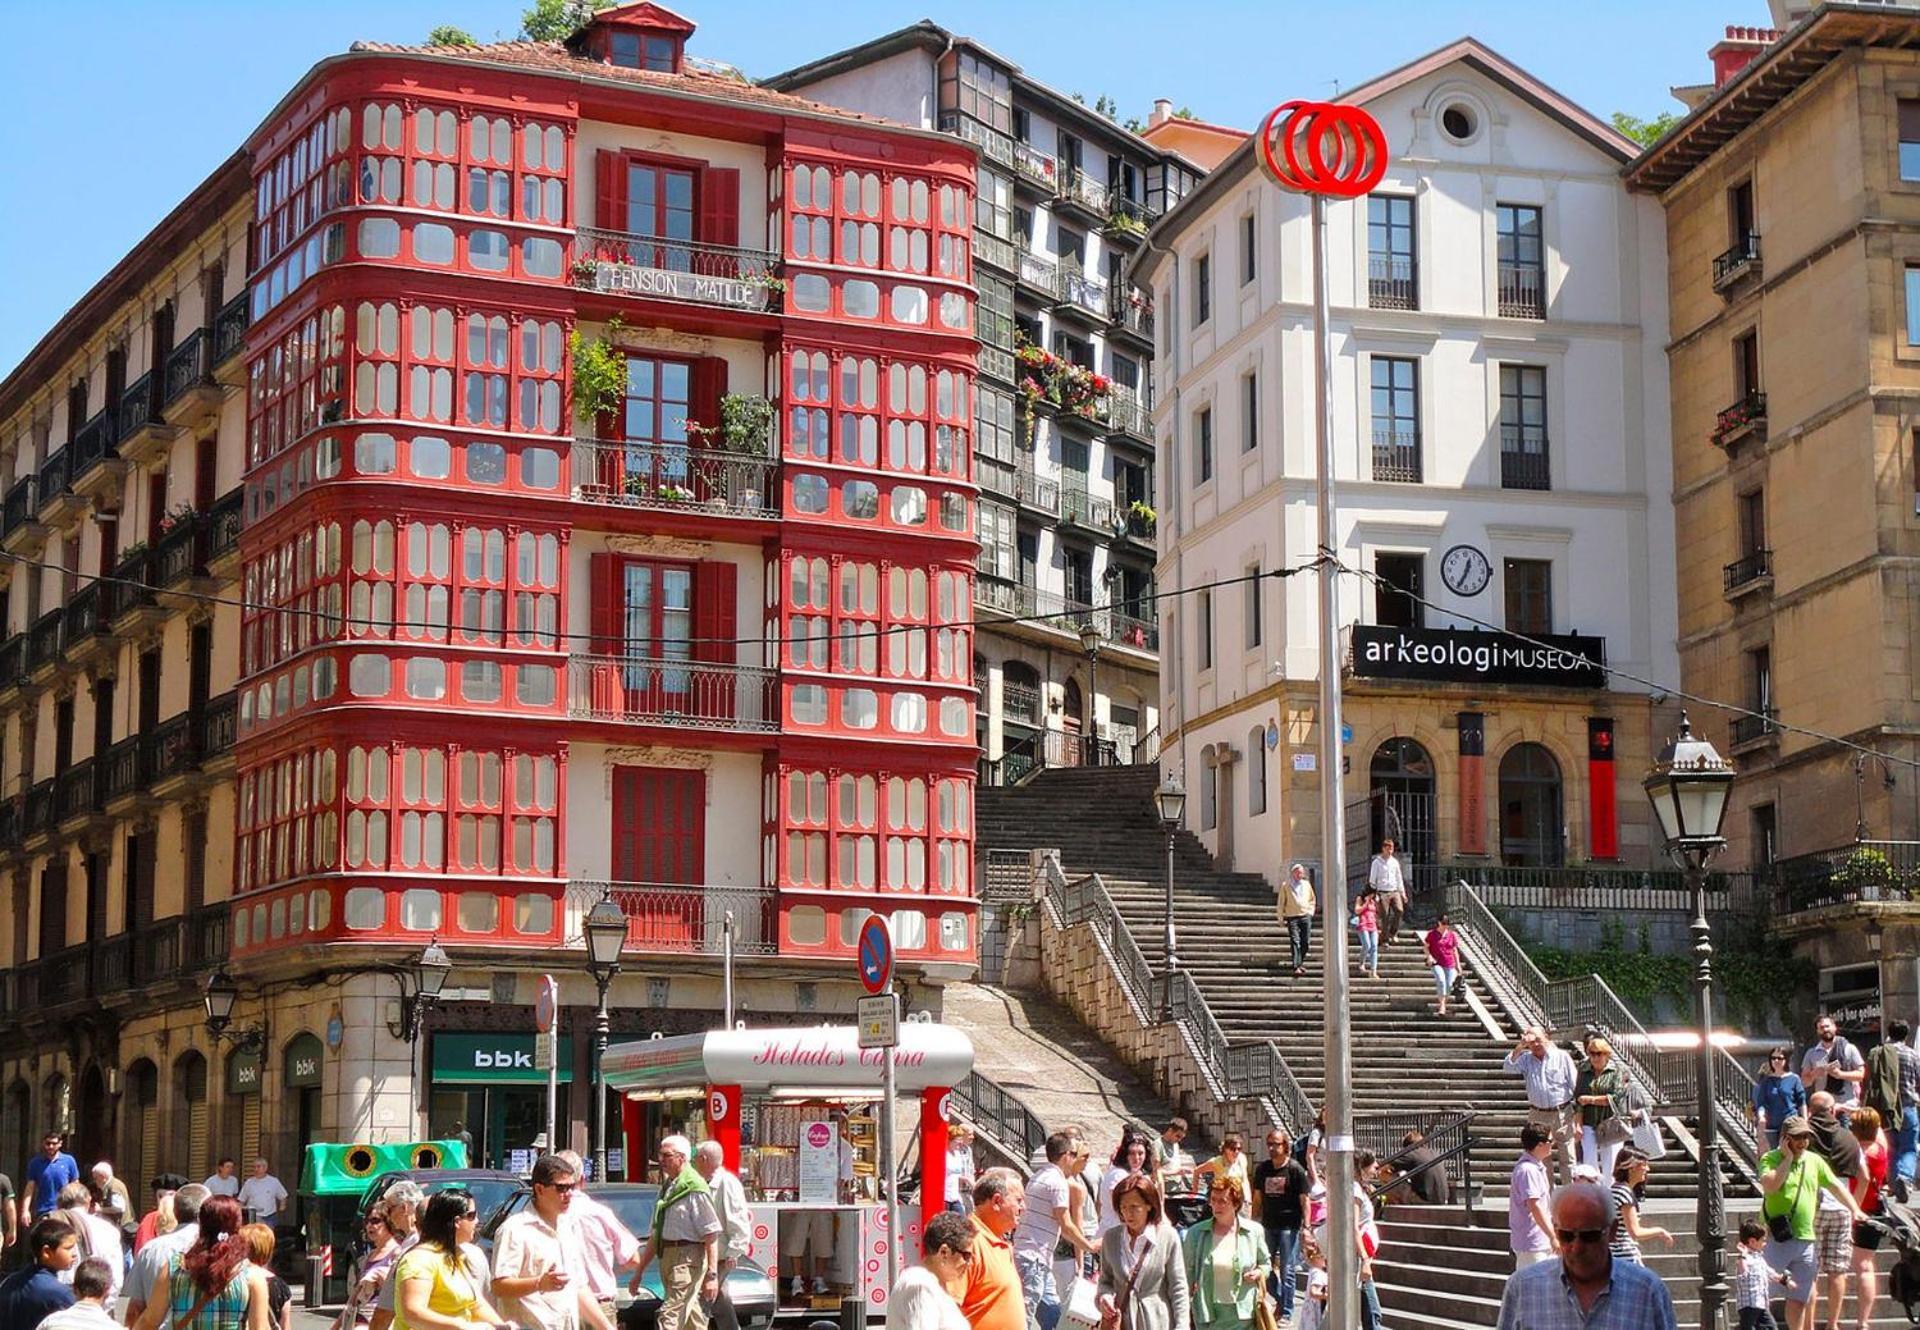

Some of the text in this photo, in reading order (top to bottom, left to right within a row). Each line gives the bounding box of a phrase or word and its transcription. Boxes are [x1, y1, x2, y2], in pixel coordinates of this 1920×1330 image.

[611, 269, 753, 304] PENSION MATILDE
[1366, 634, 1498, 672] arkeologi
[475, 1050, 532, 1067] bbk
[753, 1040, 847, 1067] Helados
[239, 1067, 255, 1082] bbk
[296, 1059, 315, 1076] bbk
[712, 1098, 723, 1113] B
